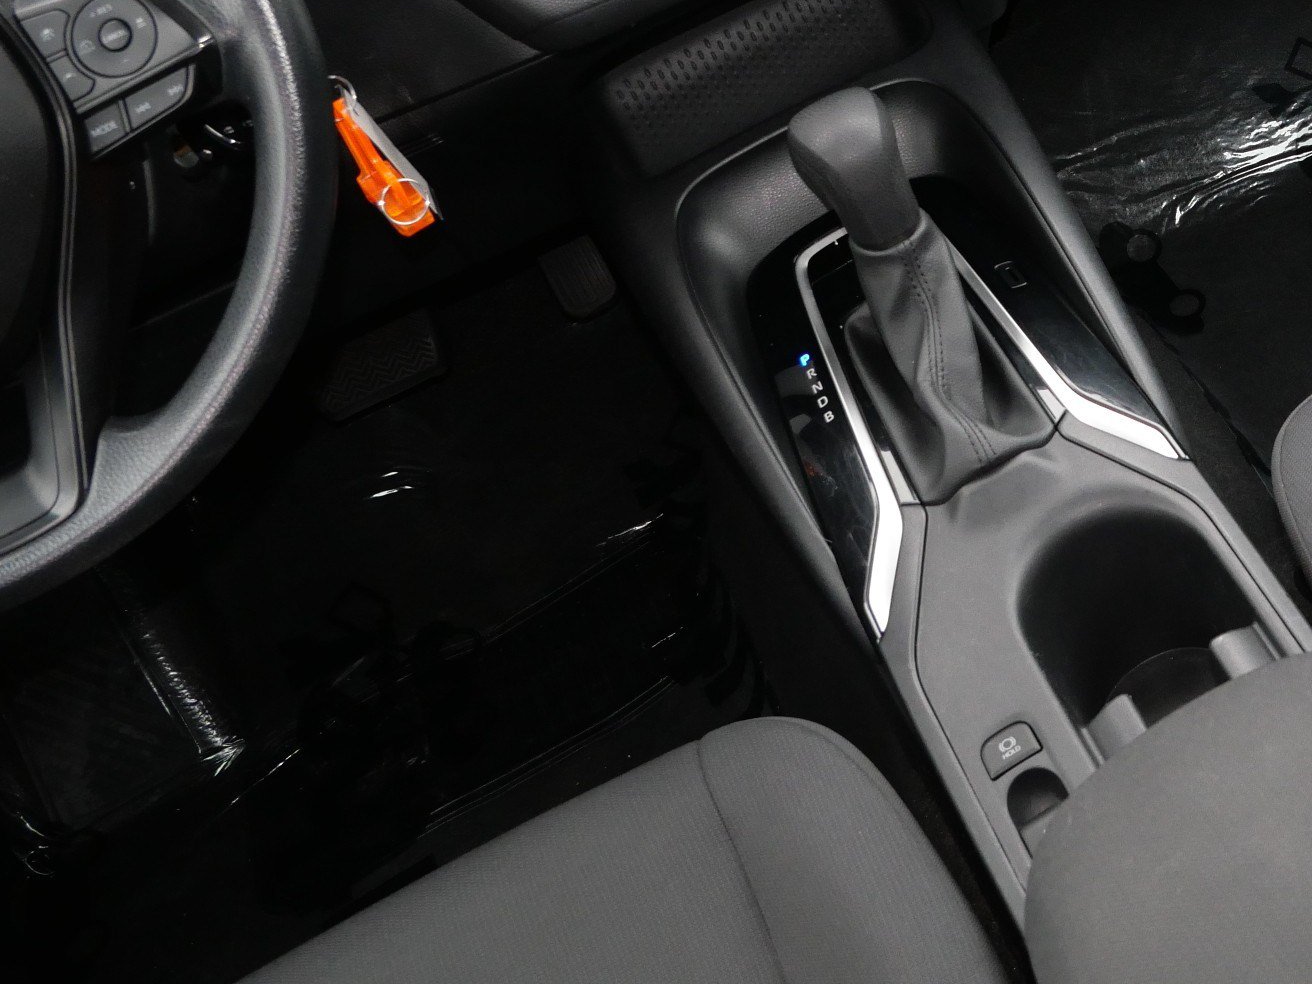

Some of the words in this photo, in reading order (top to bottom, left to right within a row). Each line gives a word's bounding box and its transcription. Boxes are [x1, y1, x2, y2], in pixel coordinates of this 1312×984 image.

[799, 353, 810, 366] P
[806, 368, 817, 379] R
[811, 381, 823, 394] N
[817, 395, 828, 408] D
[823, 410, 835, 423] B
[1002, 745, 1021, 759] HOLD
